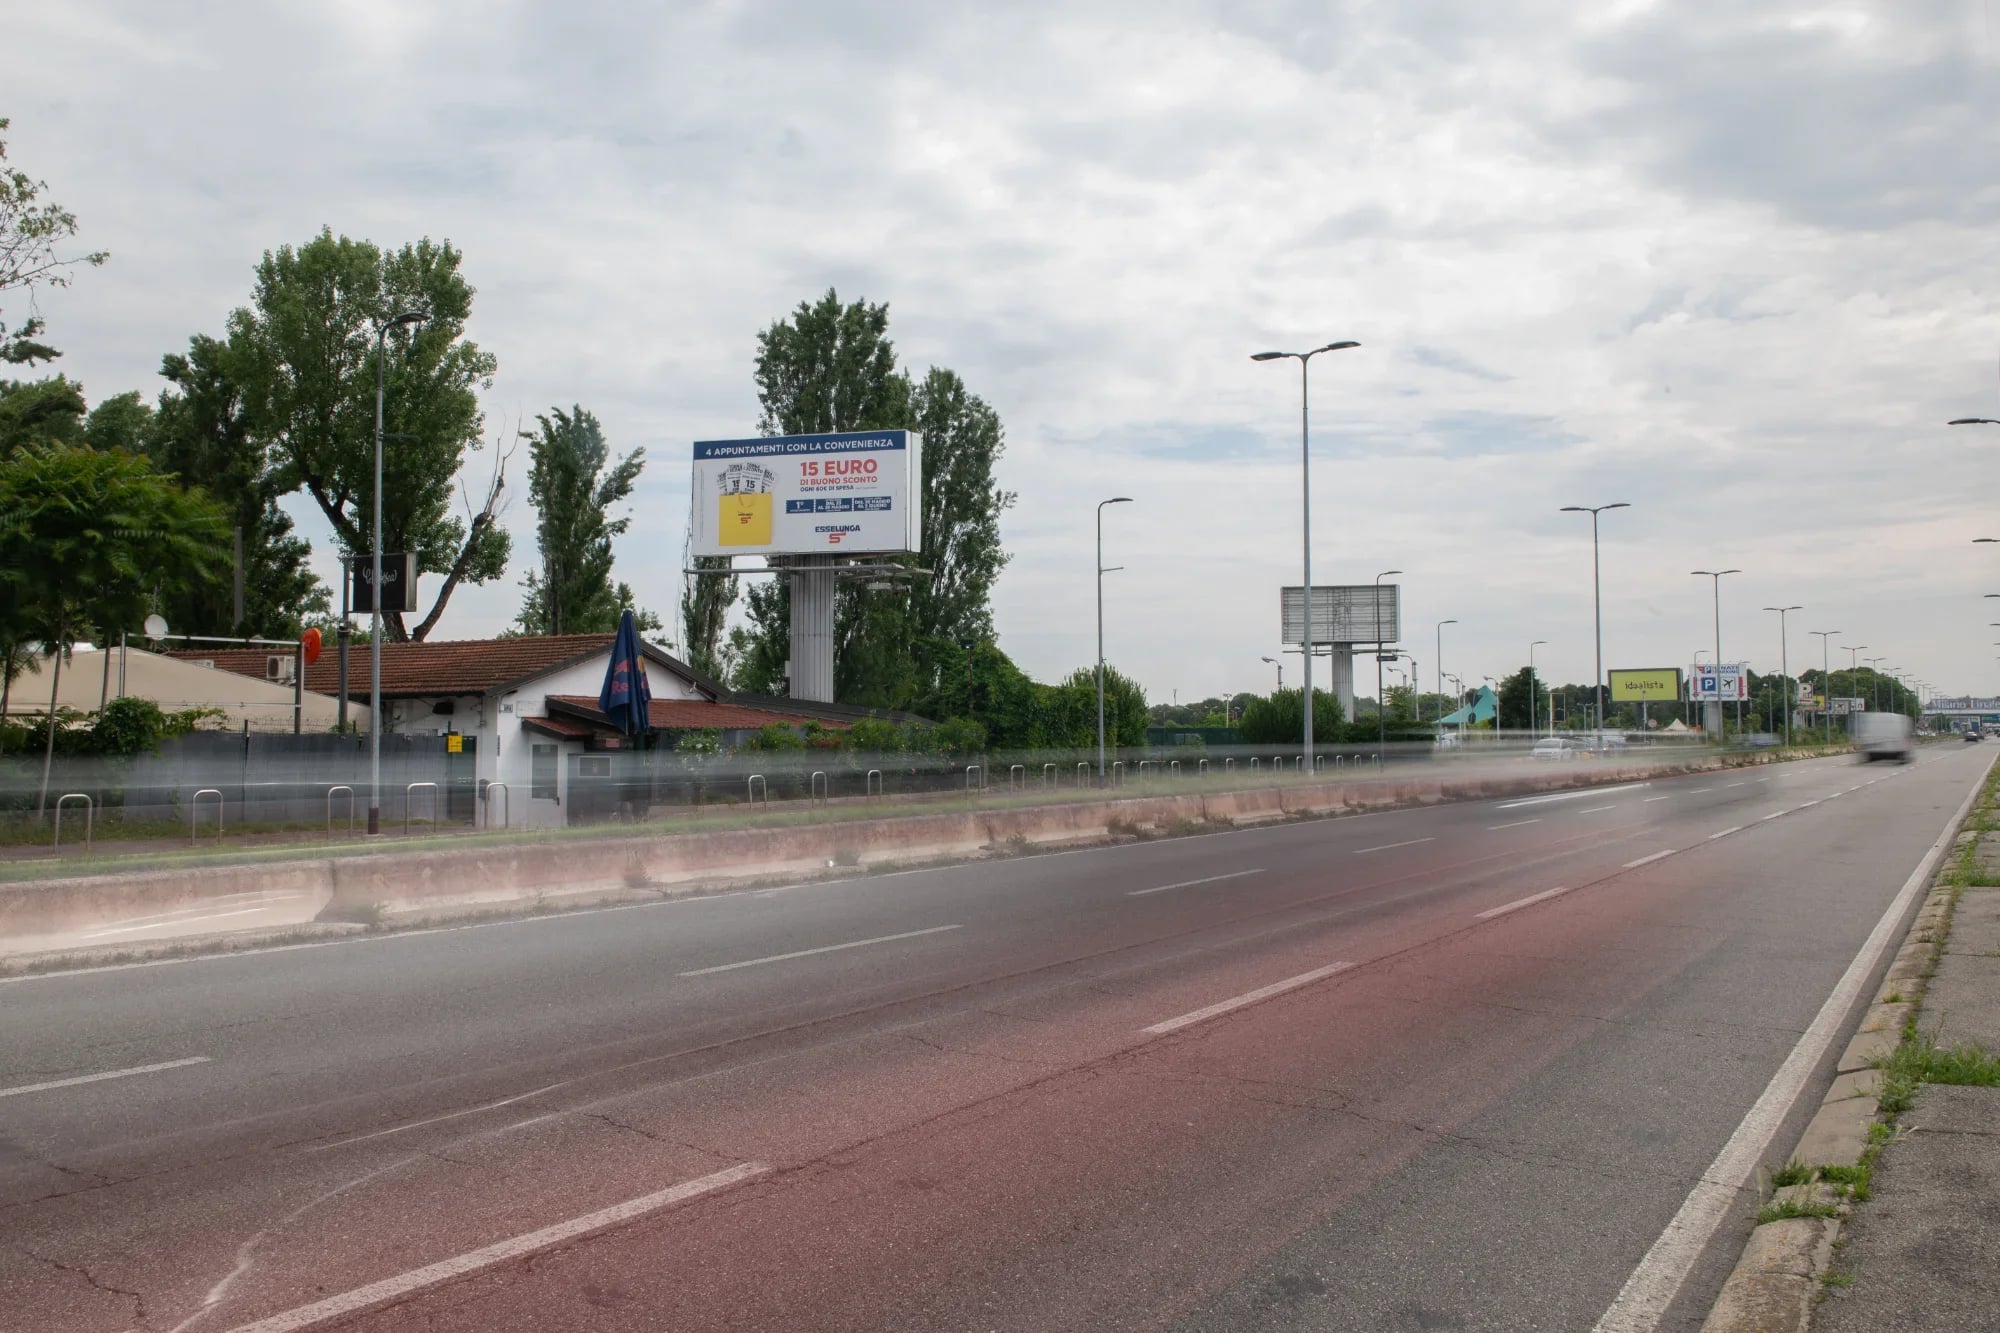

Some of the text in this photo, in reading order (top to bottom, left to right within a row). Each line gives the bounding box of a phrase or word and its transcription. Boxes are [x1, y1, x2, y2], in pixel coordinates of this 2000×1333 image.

[706, 439, 894, 456] 4 APPUNTAMENTI CON LA CONVENIENZA
[800, 459, 878, 476] 15 EURO
[746, 480, 755, 489] 15
[810, 477, 840, 485] BUONO
[843, 476, 878, 484] SCONTO
